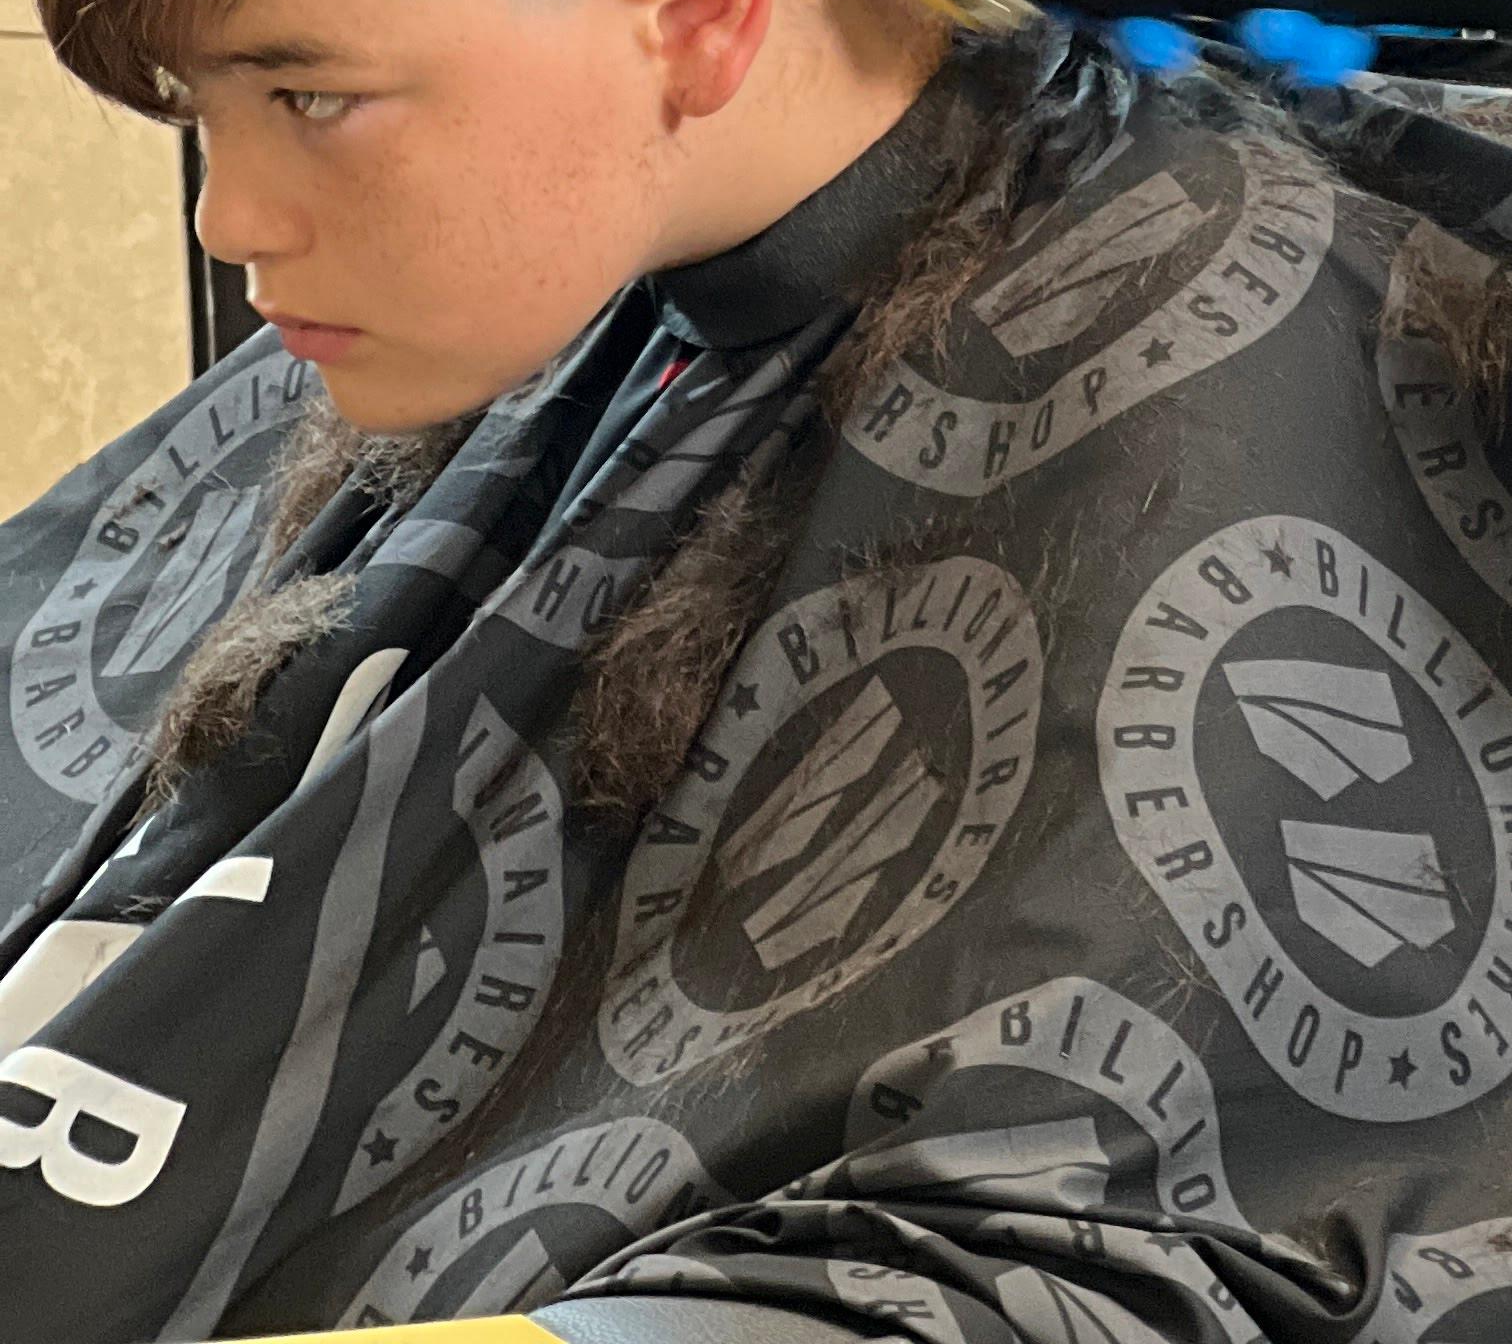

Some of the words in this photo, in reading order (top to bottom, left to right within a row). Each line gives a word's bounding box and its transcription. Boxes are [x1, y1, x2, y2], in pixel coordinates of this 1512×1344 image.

[97, 358, 308, 554] BILLIO
[863, 366, 1109, 480] RSHOP
[1000, 995, 1217, 1212] BILLIO
